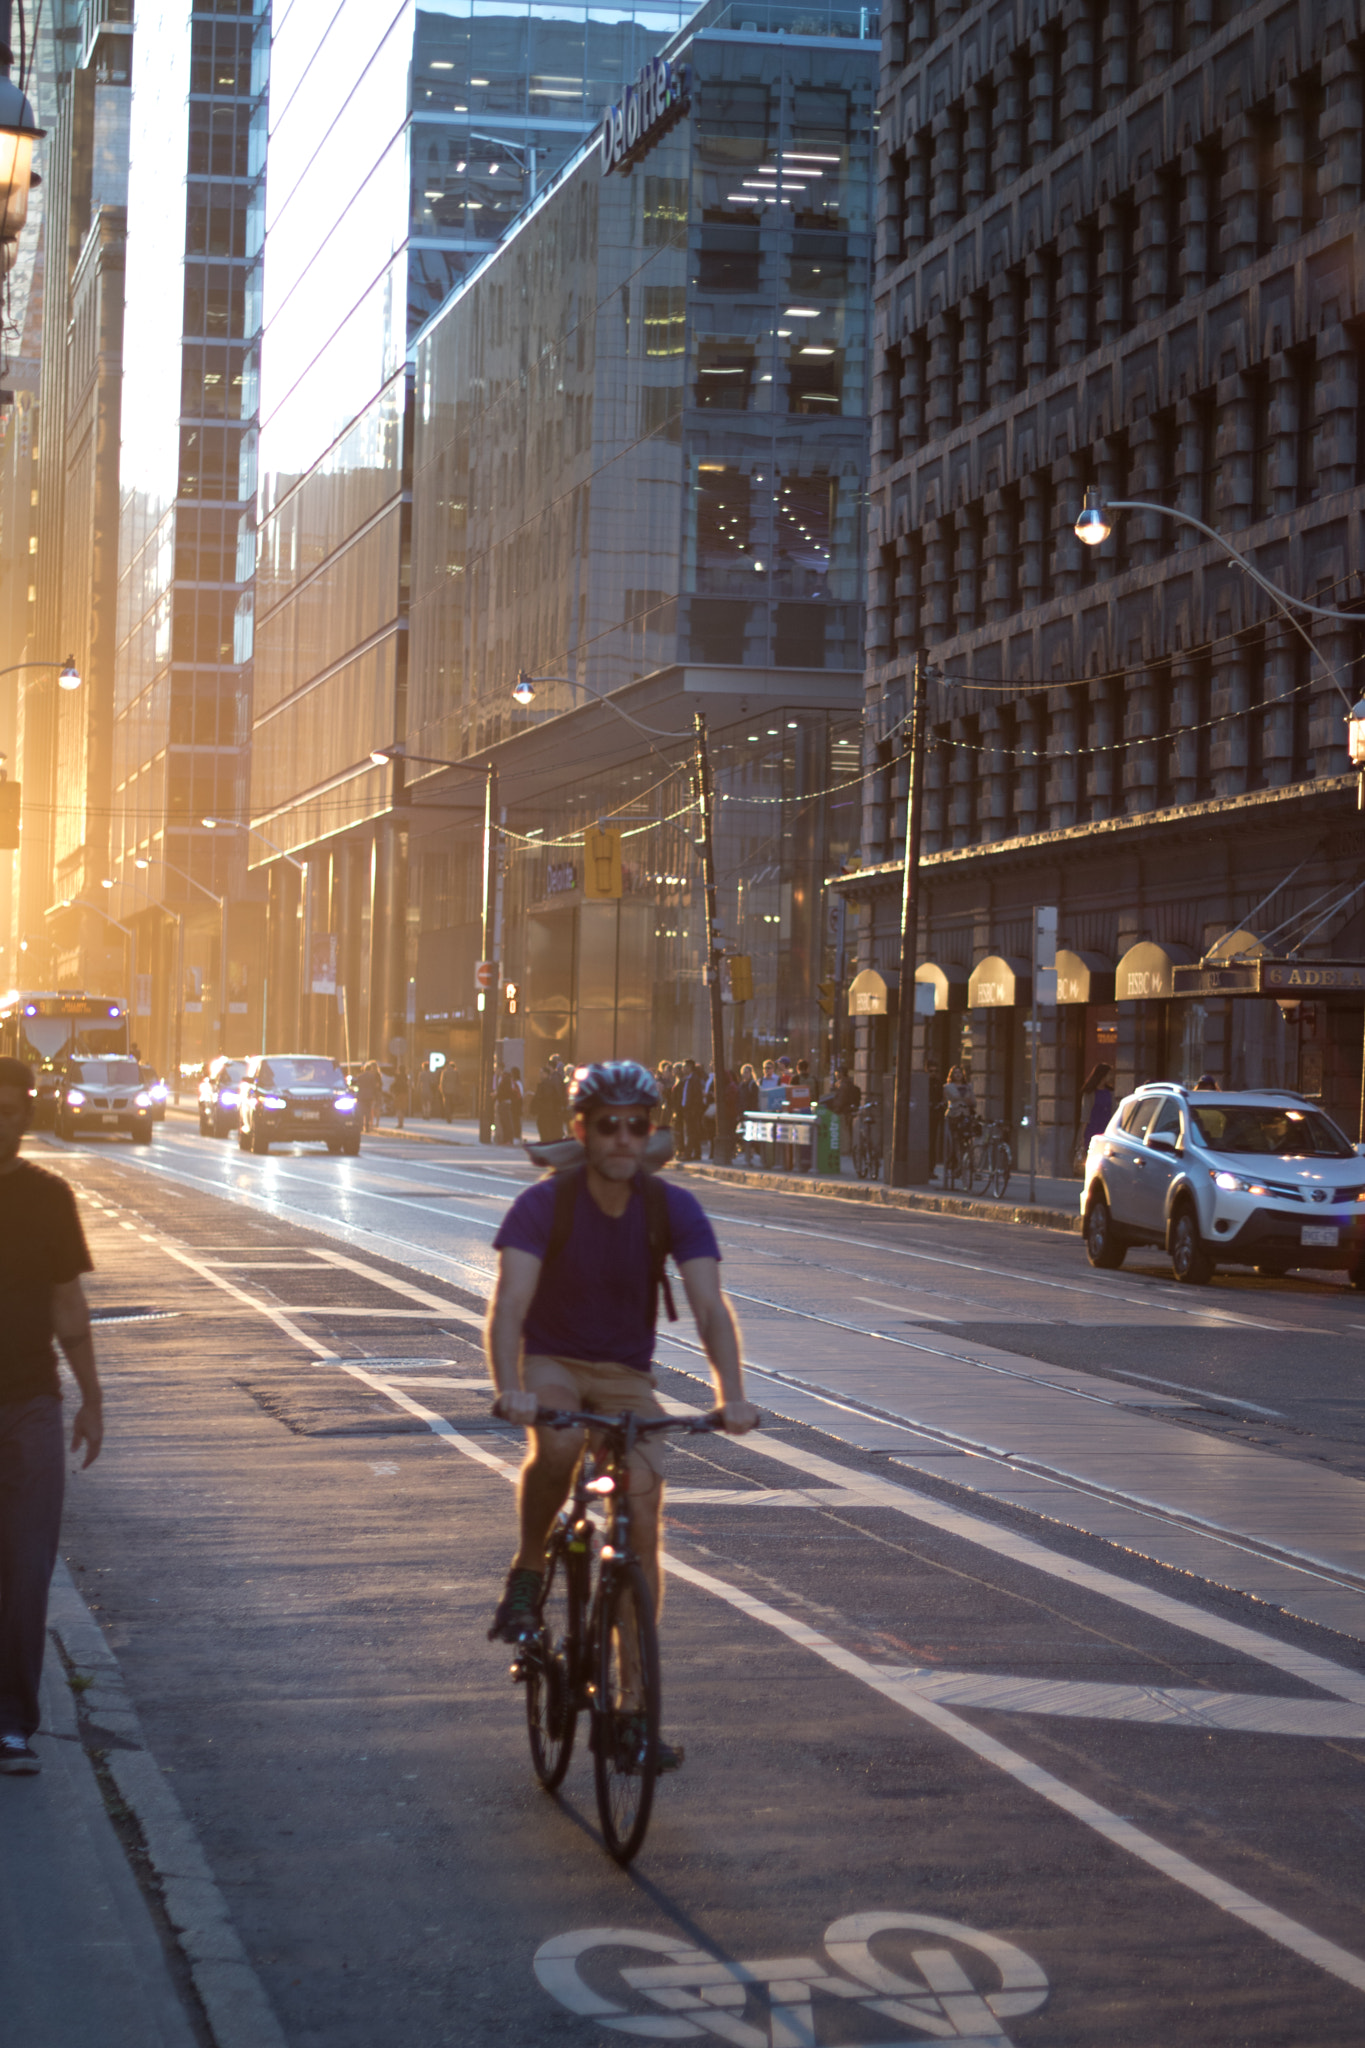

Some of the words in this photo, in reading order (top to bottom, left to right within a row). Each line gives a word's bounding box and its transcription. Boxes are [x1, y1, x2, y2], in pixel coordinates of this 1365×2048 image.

[1127, 972, 1150, 996] HSBC
[1270, 968, 1283, 985] 6
[977, 982, 996, 1004] HSBC
[1057, 978, 1068, 1000] BC
[429, 1051, 446, 1072] P
[829, 1113, 839, 1150] metro
